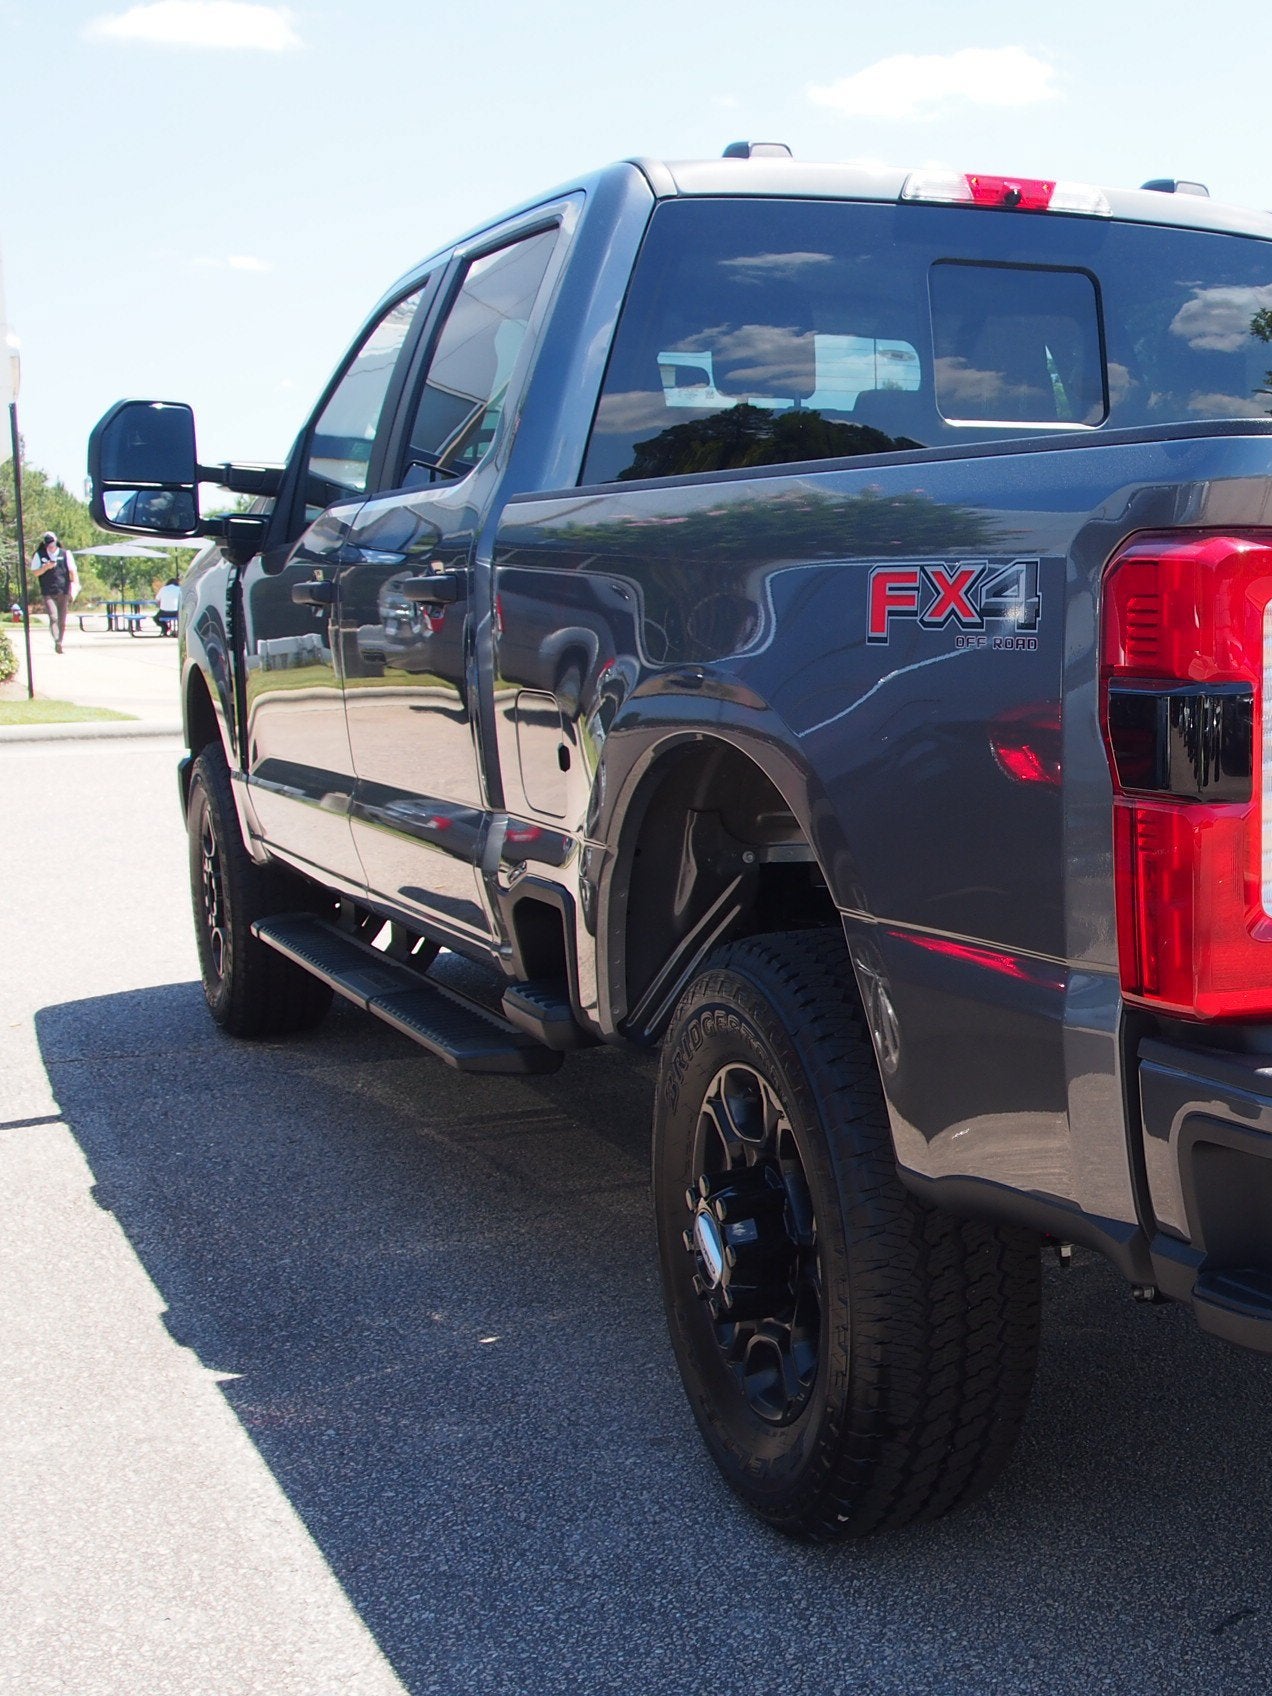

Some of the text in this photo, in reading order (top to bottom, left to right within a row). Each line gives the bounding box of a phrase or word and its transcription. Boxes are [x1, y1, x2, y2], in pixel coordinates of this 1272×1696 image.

[866, 558, 1042, 646] FX4
[955, 635, 1039, 650] OFF ROAD
